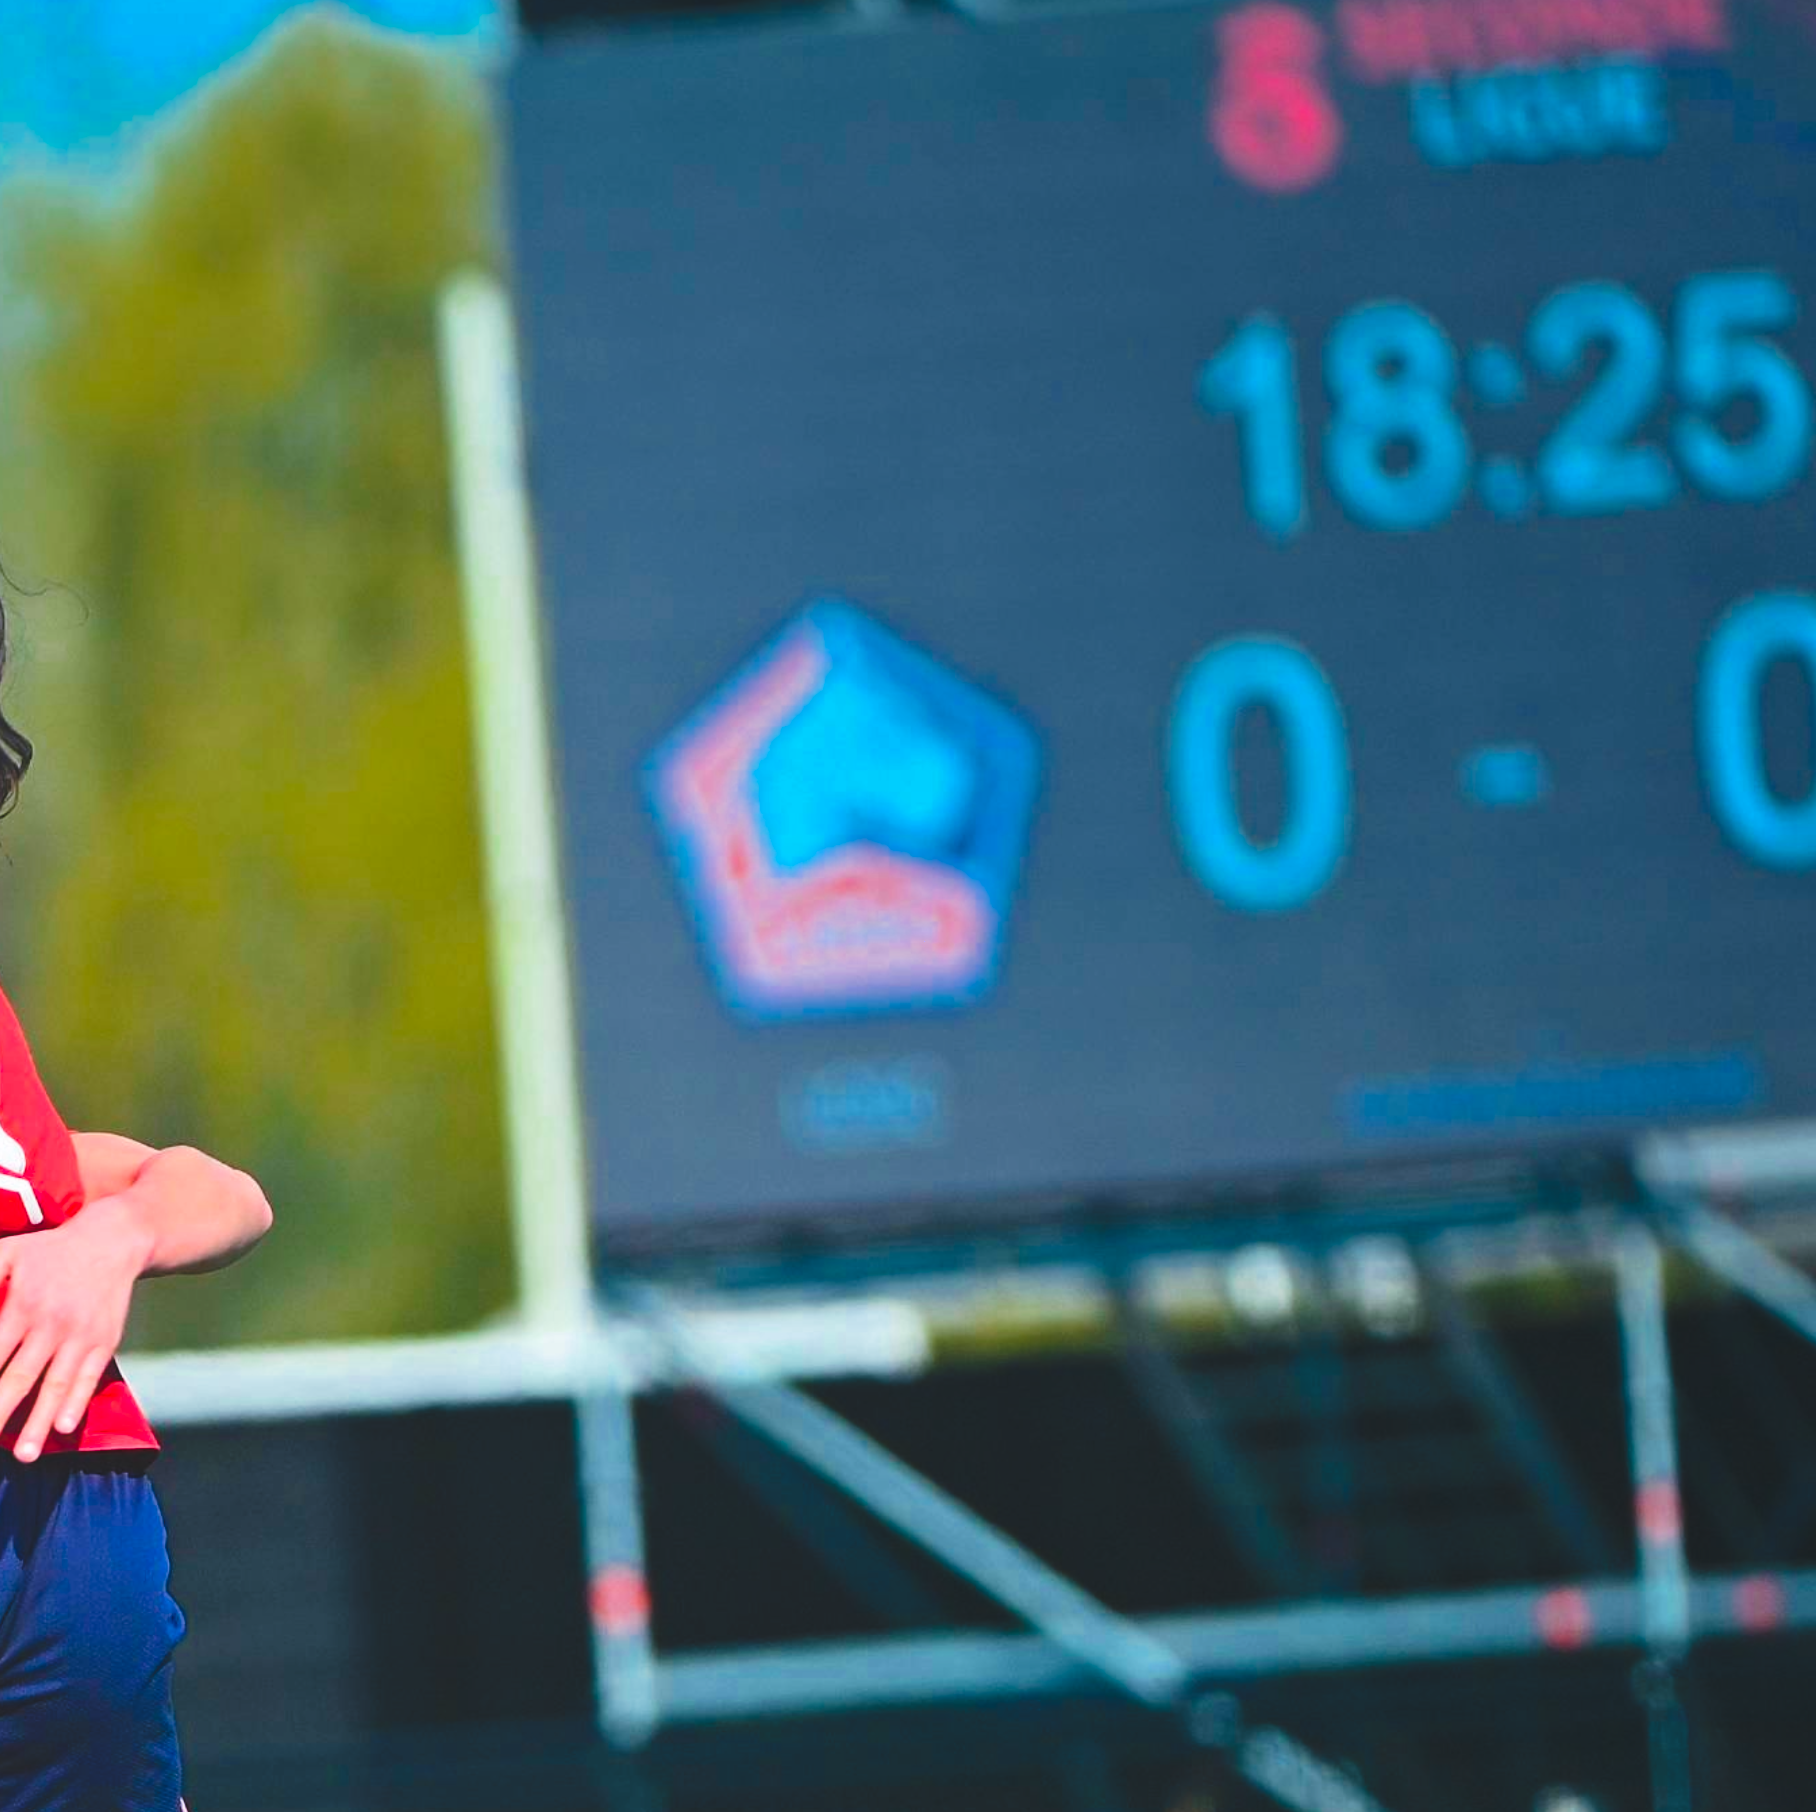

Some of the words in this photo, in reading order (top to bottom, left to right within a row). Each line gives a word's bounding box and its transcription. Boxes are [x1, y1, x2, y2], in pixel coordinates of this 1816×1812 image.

[1197, 271, 1811, 540] 18:25
[1169, 635, 1348, 912] 0
[1698, 592, 1816, 870] 0
